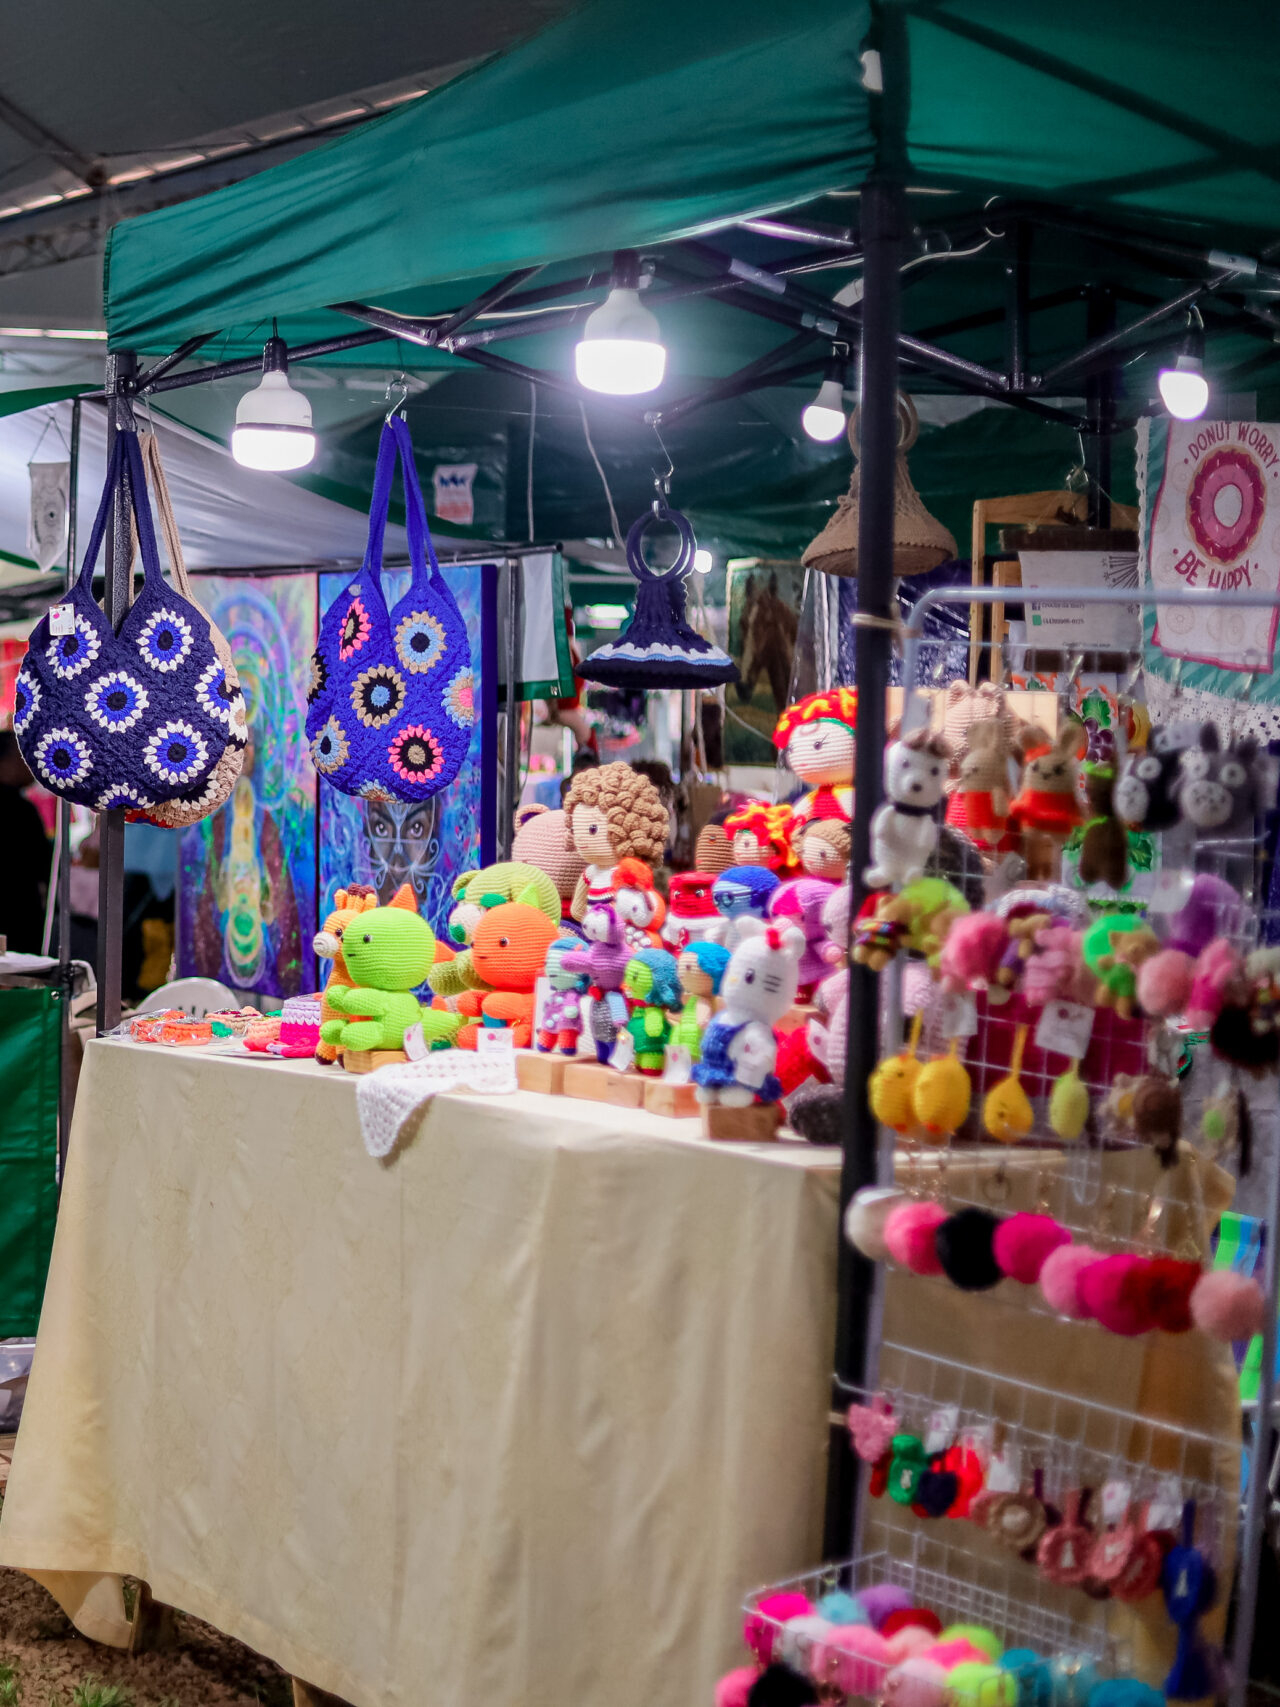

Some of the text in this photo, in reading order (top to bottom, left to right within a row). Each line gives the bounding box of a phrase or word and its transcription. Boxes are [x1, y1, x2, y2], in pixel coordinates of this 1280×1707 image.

[1188, 422, 1279, 469] DONUT WORRY
[1174, 550, 1252, 591] BE HAPPY
